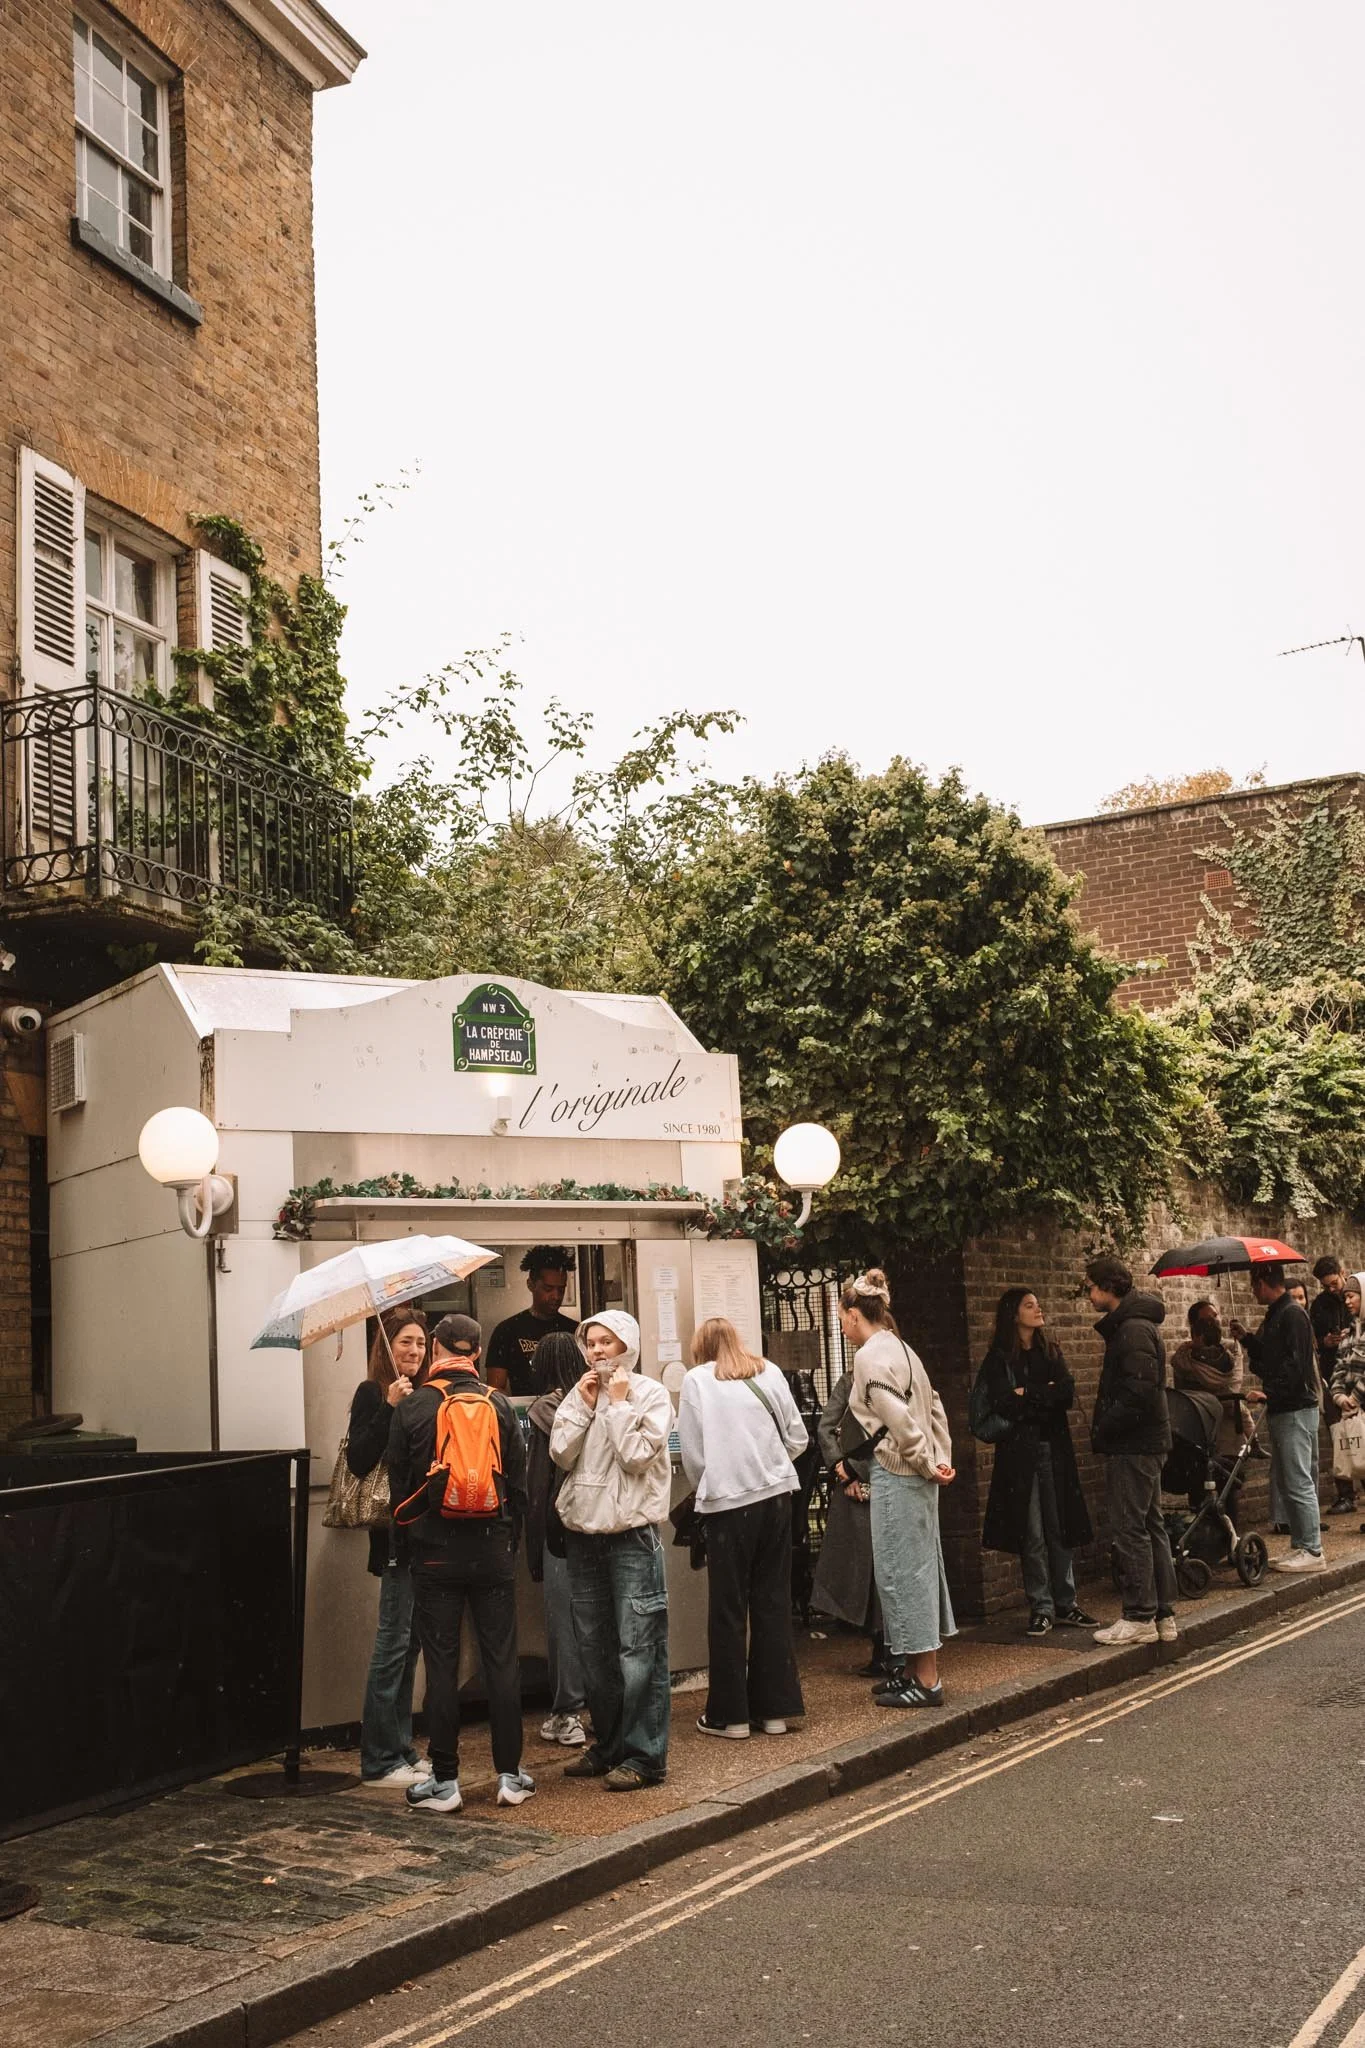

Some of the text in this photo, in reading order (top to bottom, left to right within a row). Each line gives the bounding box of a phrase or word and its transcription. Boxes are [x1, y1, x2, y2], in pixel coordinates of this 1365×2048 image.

[482, 1002, 506, 1014] NW 3
[466, 1025, 524, 1041] LA CRÊPERIE
[490, 1040, 501, 1049] DE
[469, 1048, 522, 1063] HAMPSTEAD
[519, 1059, 688, 1132] l'originale
[663, 1122, 721, 1135] SINCE 1980
